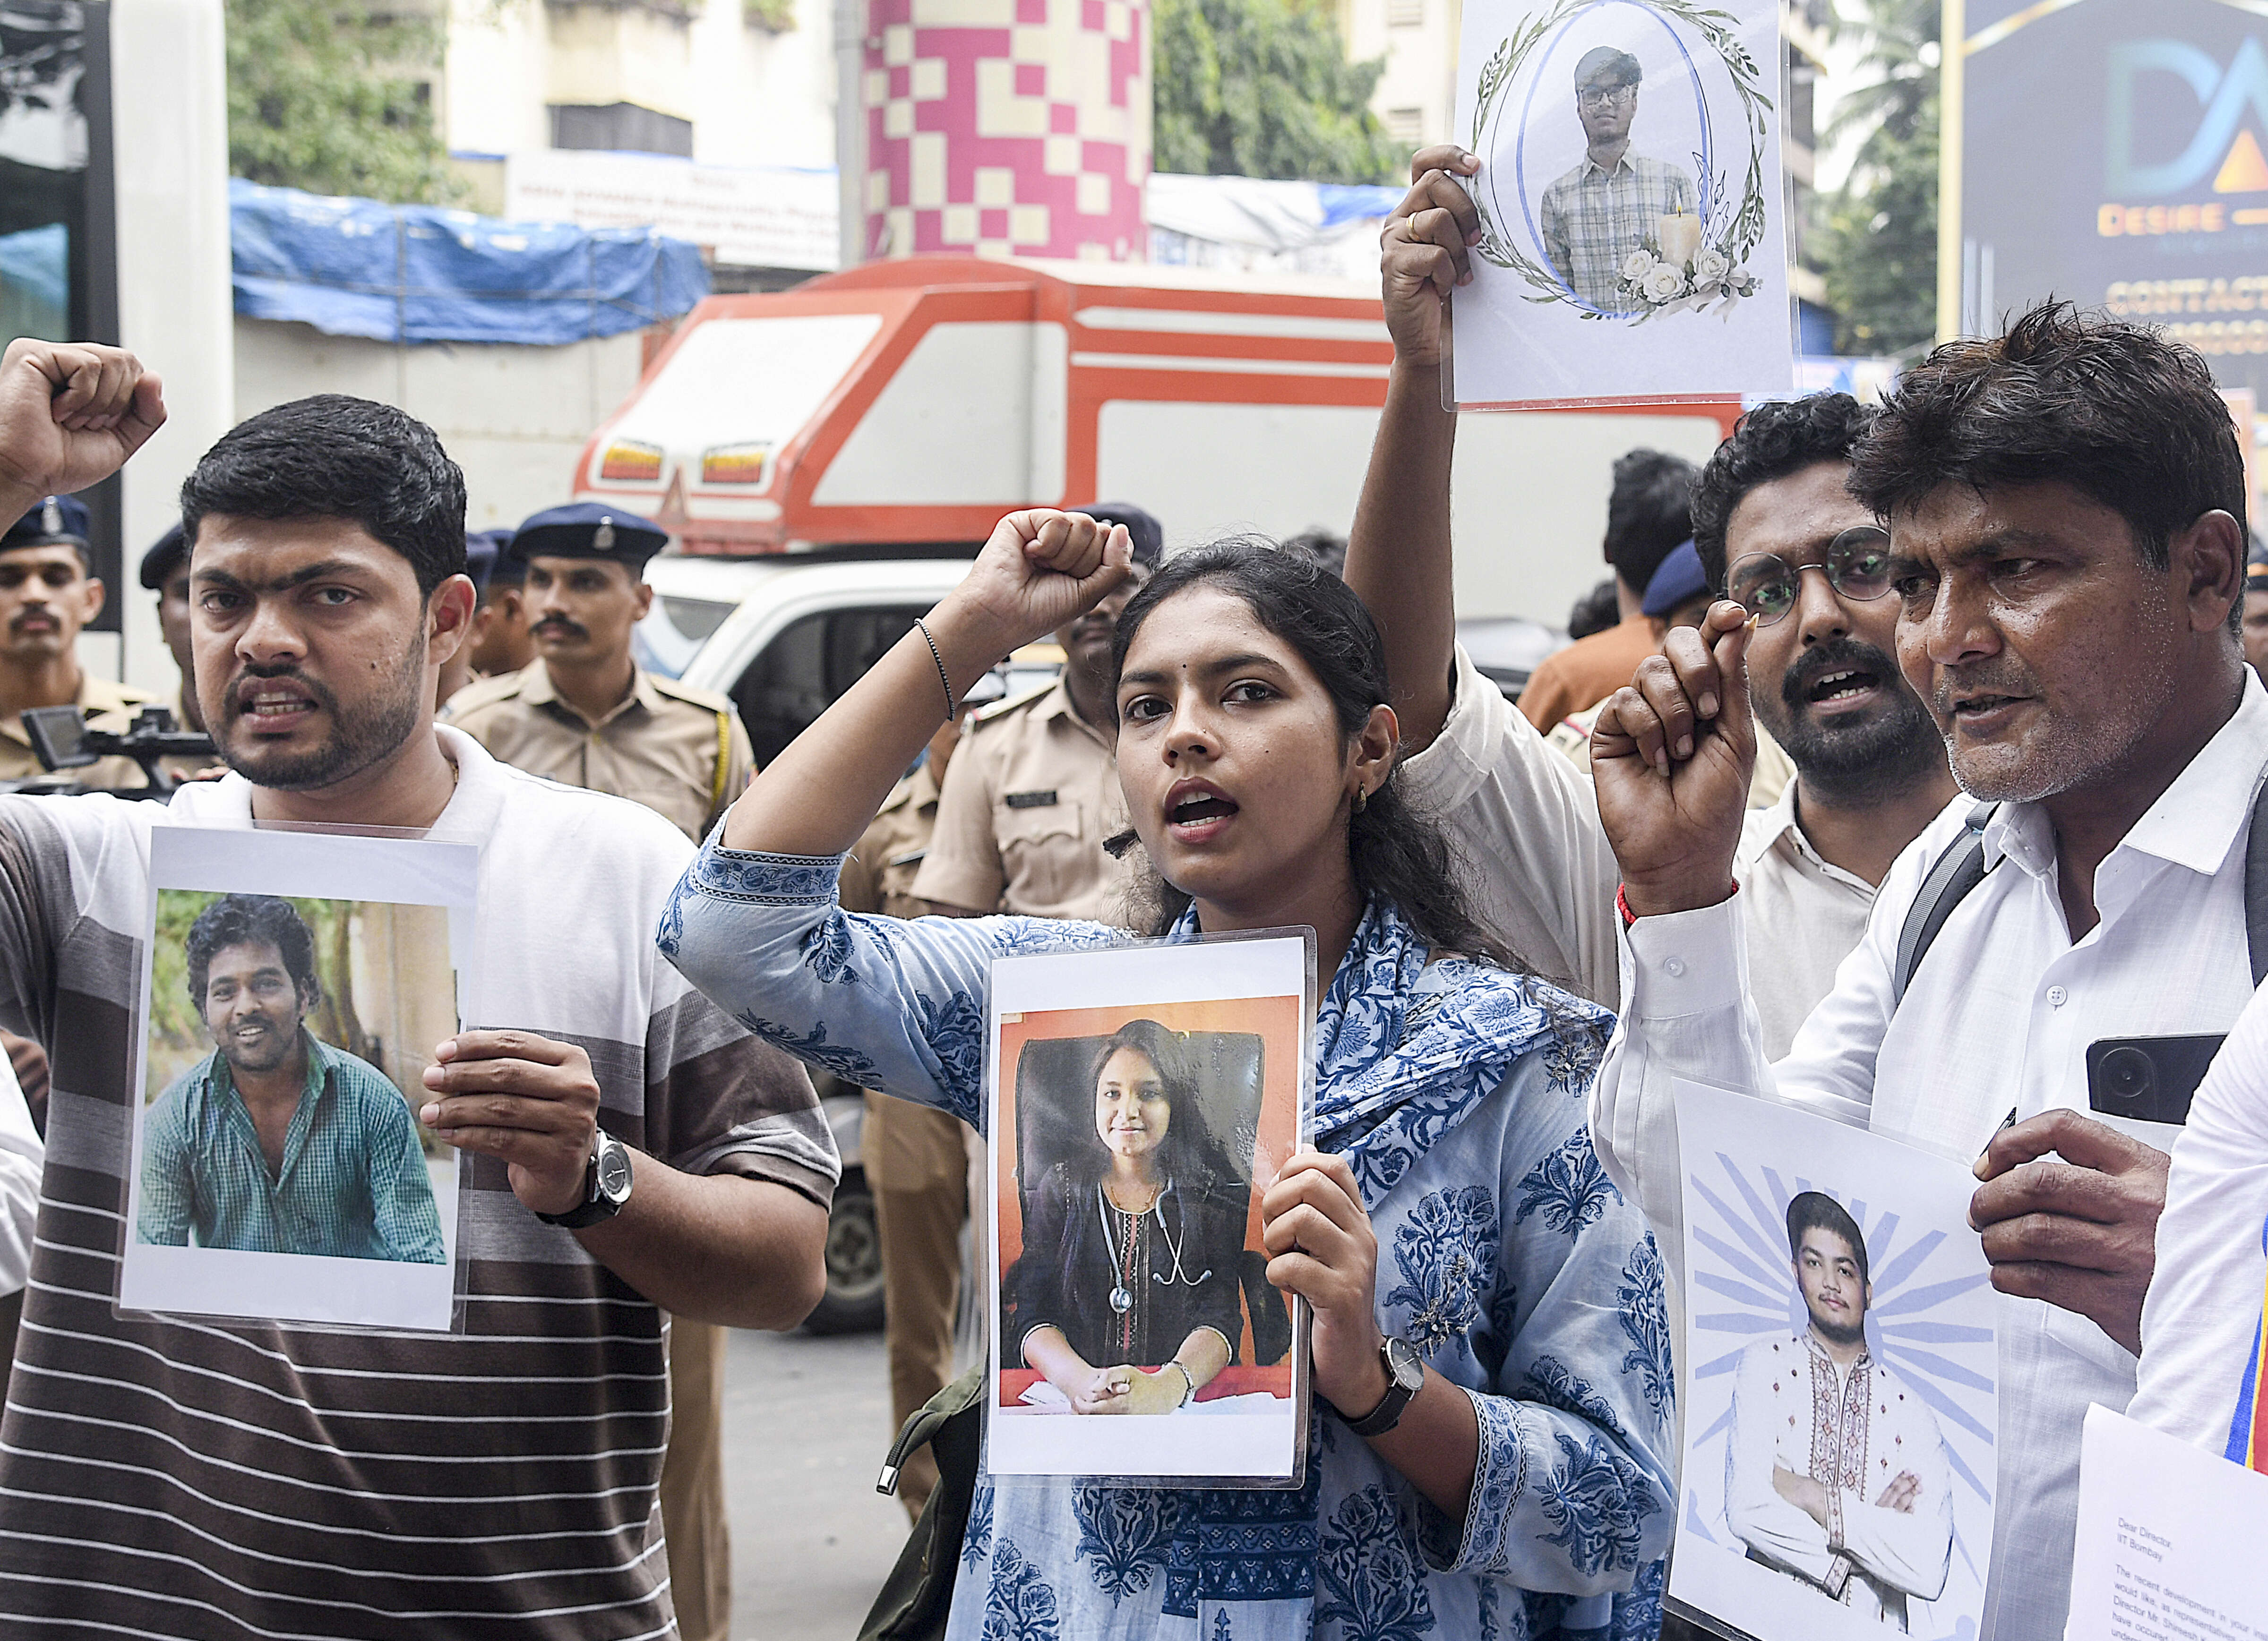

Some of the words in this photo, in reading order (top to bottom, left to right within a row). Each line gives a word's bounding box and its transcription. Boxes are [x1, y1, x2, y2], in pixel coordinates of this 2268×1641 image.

[2118, 1517, 2137, 1532] Dear
[2117, 1532, 2128, 1545] IIT
[2130, 1538, 2163, 1563] Bombay
[2113, 1594, 2145, 1616] Director
[2114, 1581, 2137, 1598] would
[2161, 1603, 2170, 1613] as
[2116, 1564, 2131, 1578] The
[2134, 1574, 2160, 1592] recent
[2163, 1587, 2215, 1617] development
[2230, 1618, 2250, 1632] your
[2112, 1610, 2131, 1627] have
